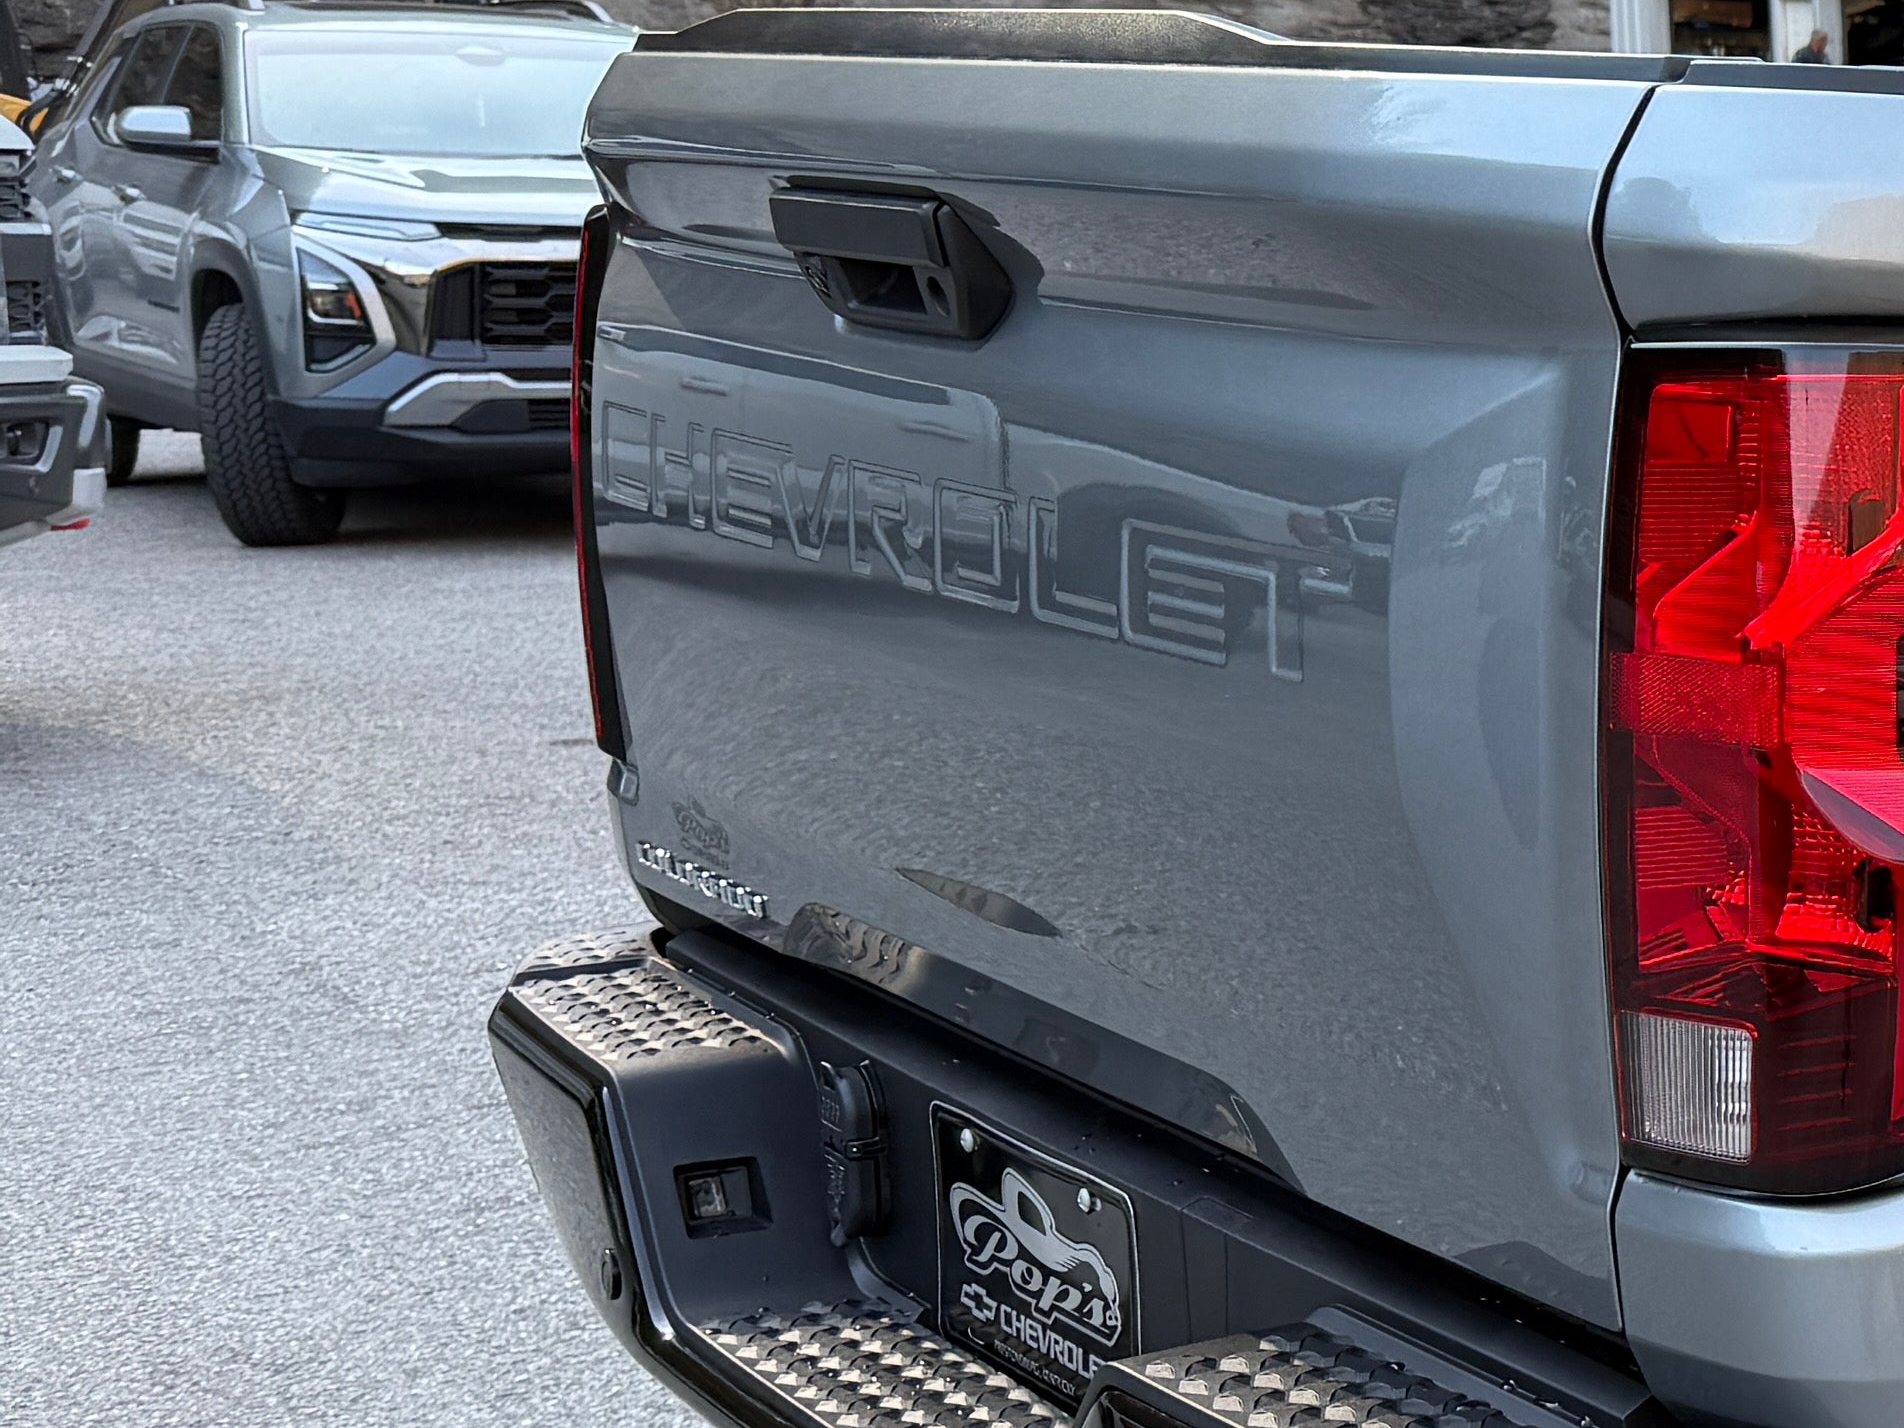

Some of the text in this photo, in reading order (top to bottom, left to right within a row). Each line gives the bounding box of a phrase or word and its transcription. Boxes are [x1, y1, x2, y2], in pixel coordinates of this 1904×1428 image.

[599, 400, 1356, 683] CHEVROLET
[964, 1215, 1110, 1327] Pop's
[1000, 1306, 1104, 1379] CHEVROLE
